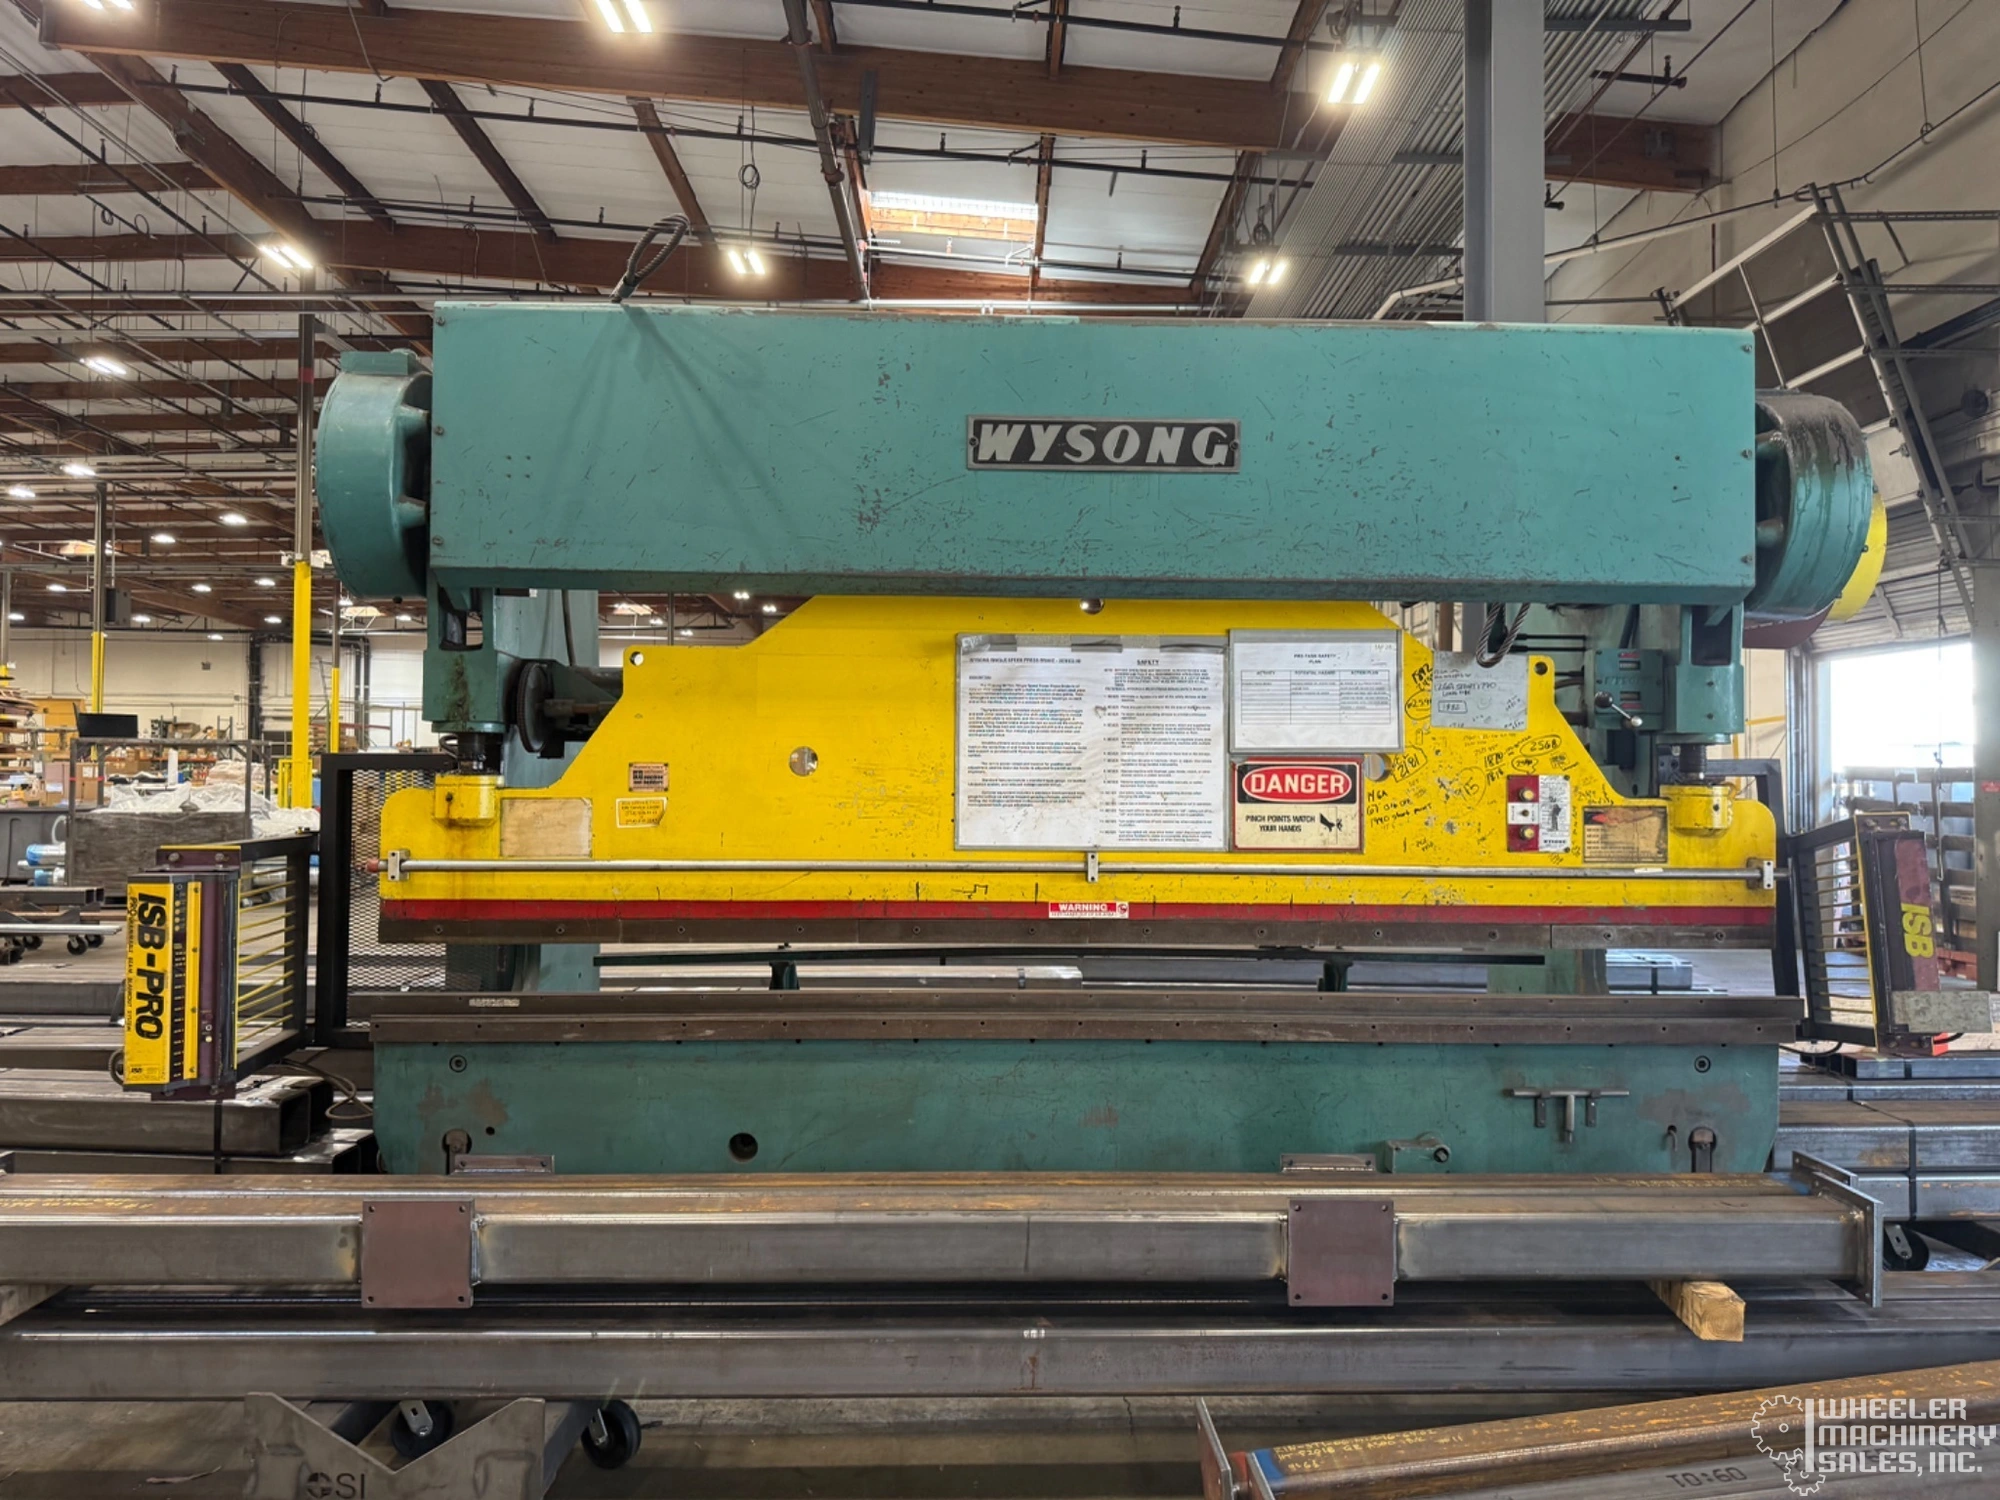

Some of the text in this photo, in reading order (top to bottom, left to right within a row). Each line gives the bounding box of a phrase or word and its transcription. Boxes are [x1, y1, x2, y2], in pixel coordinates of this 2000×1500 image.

[977, 423, 1230, 465] WYSONG
[1250, 773, 1345, 794] DANGER
[1245, 814, 1316, 822] PINCH POINTS WATCH
[1259, 824, 1302, 832] YOUR HANDS
[1059, 903, 1108, 912] WARNING
[1901, 902, 1935, 958] ISB
[135, 892, 167, 1040] ISB-PRO
